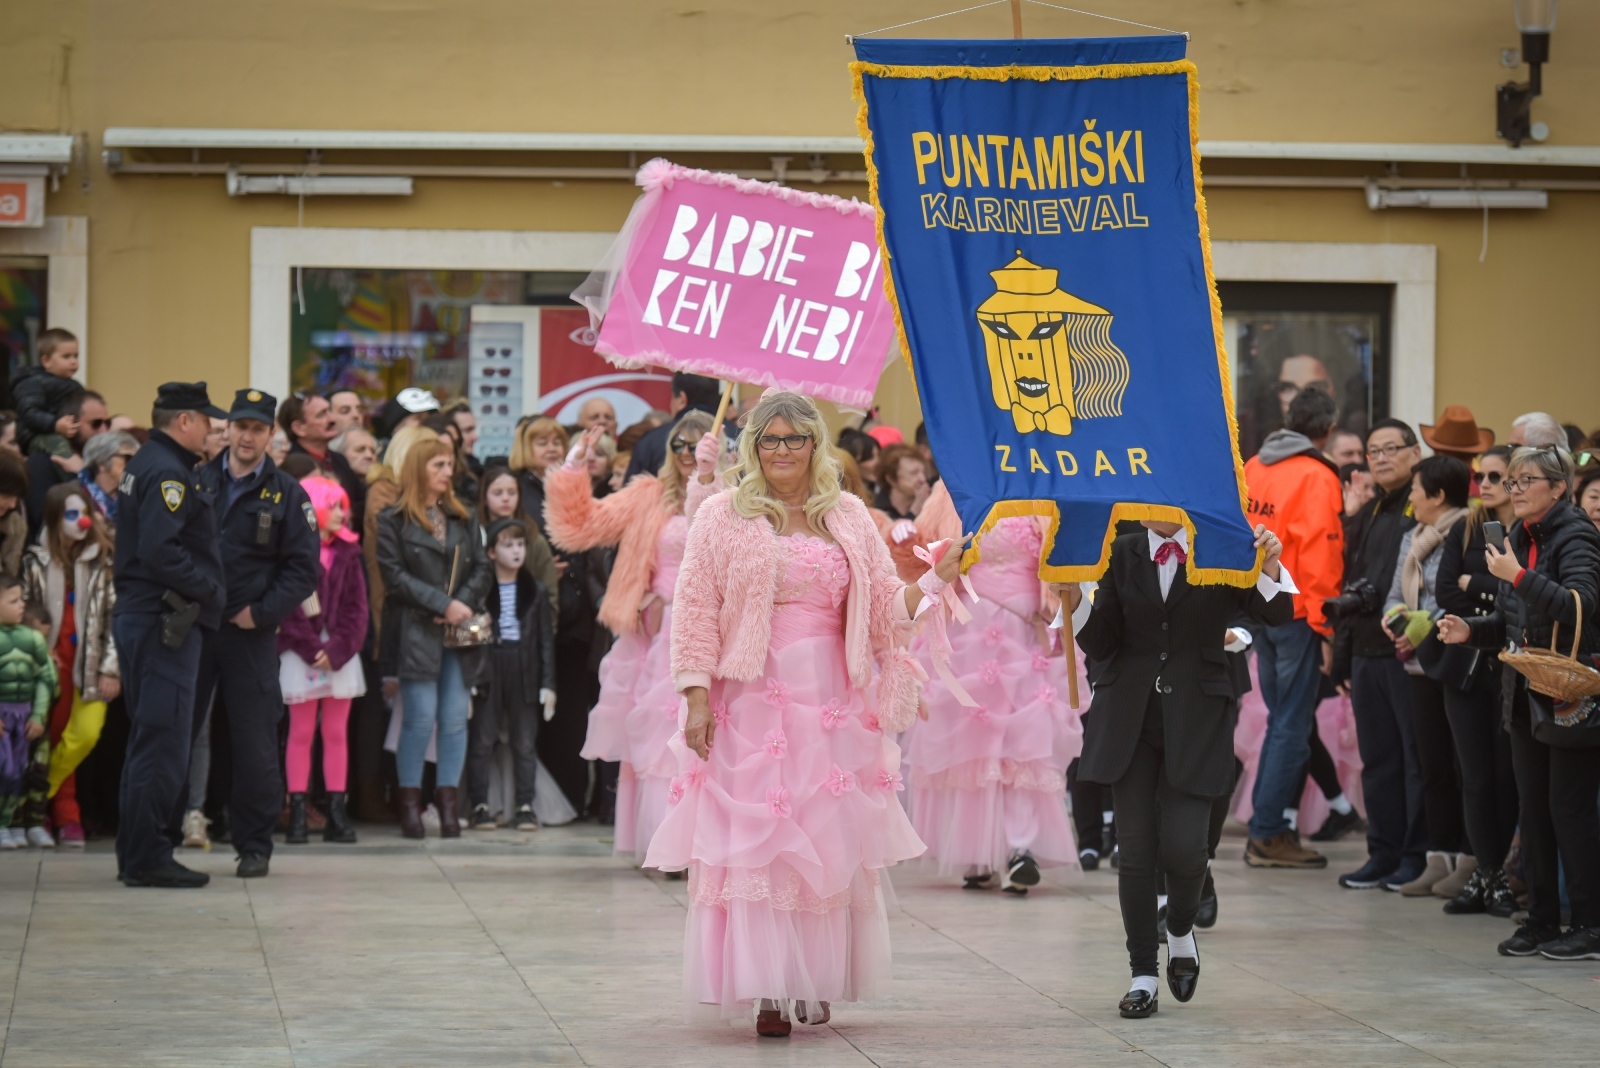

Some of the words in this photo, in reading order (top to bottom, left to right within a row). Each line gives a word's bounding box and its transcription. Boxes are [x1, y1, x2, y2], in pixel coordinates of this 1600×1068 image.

[911, 118, 1146, 191] PUNTAMIŠKI
[920, 192, 1149, 235] KARNEVAL
[662, 204, 814, 286] BARBIE
[834, 240, 881, 301] BI
[641, 268, 732, 339] KEN
[760, 293, 864, 365] NEBI
[994, 444, 1152, 477] ZADAR
